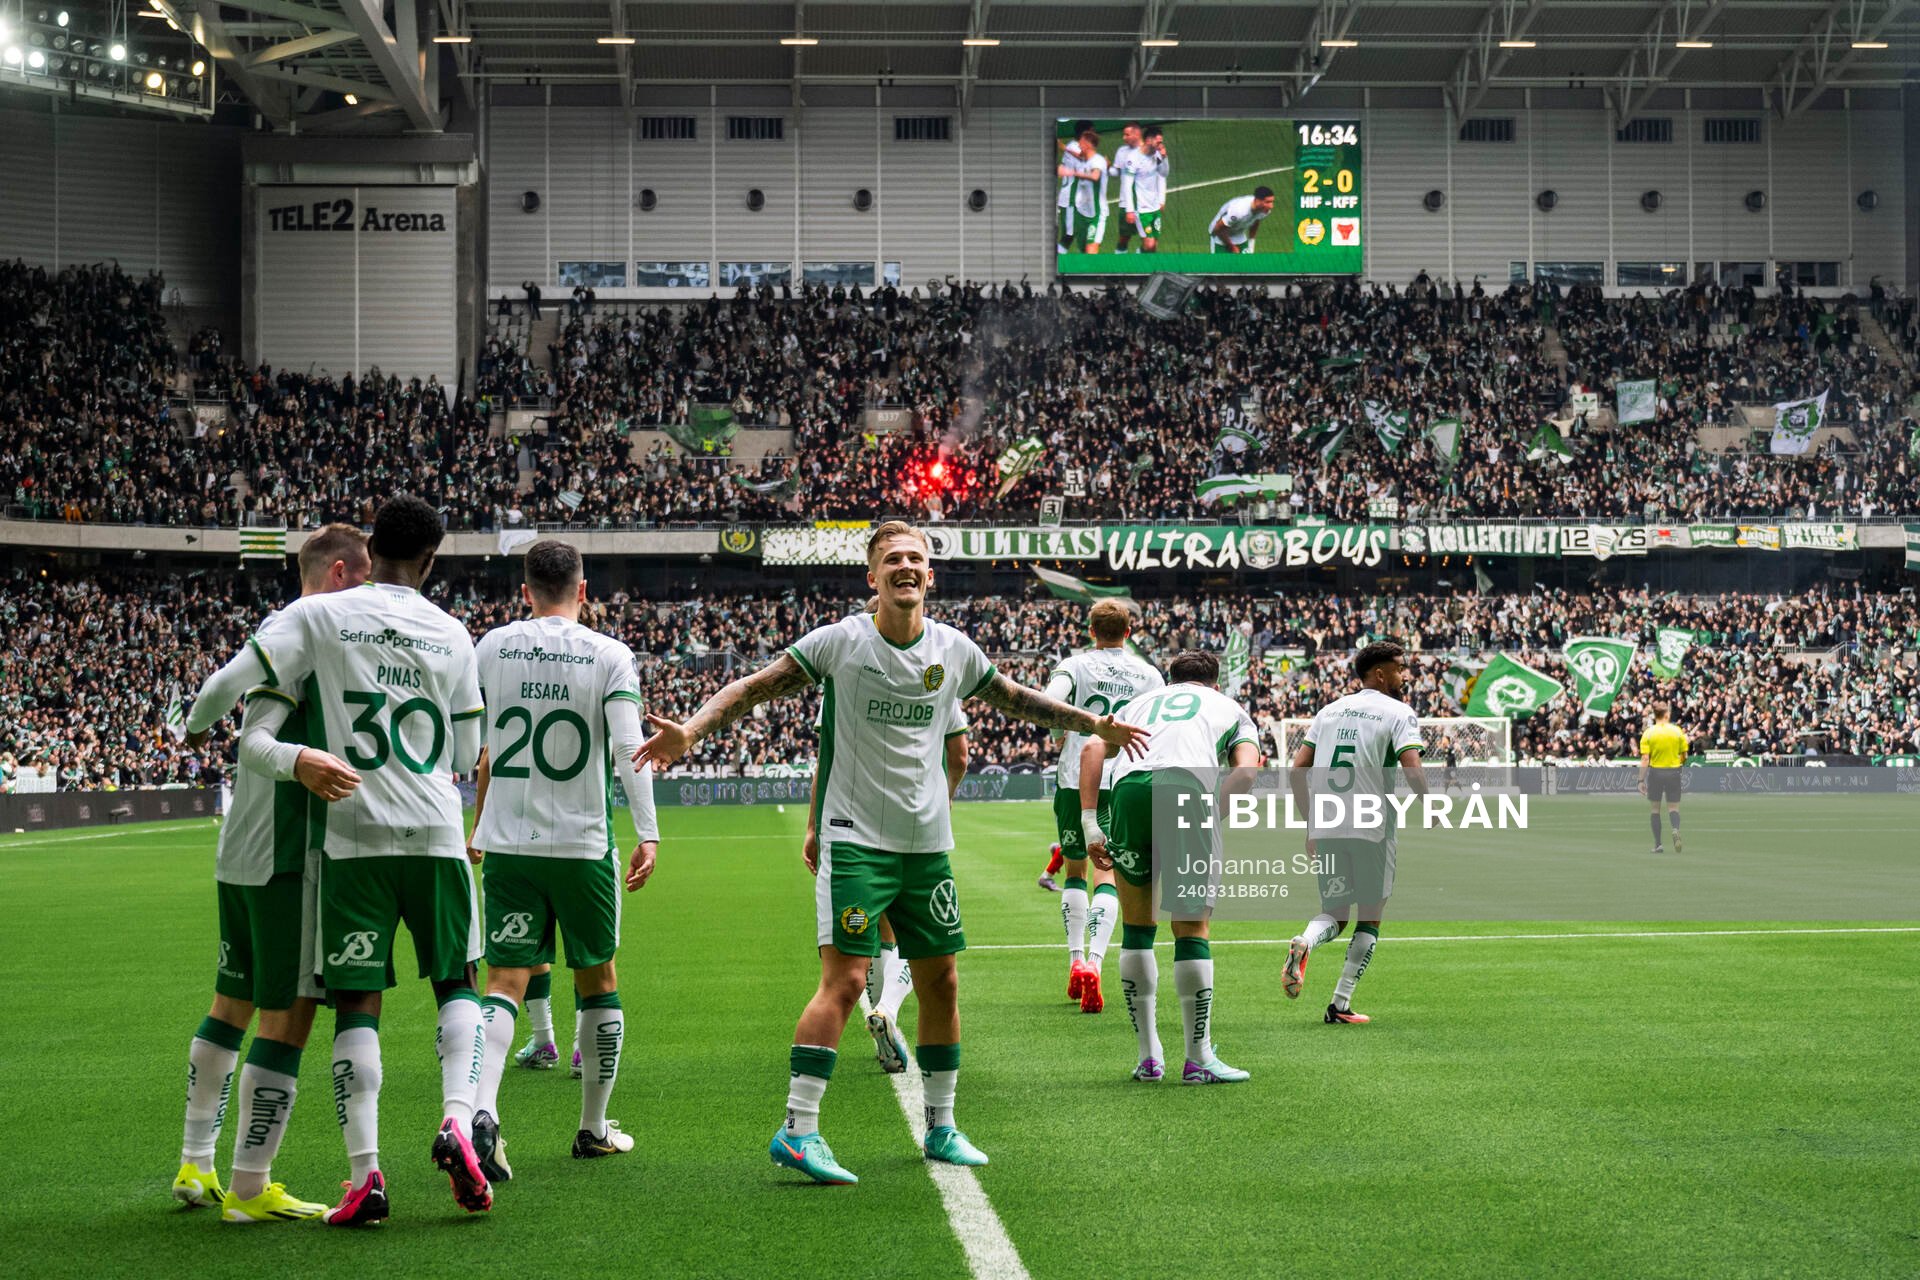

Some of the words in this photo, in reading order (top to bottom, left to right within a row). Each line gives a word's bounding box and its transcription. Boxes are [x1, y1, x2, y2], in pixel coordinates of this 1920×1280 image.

[1299, 124, 1358, 146] 16:34
[268, 199, 354, 231] TELE2
[360, 207, 446, 231] Arena
[1300, 196, 1322, 209] HIF
[1333, 196, 1358, 209] KFF
[961, 530, 1098, 556] ULTRAS
[1107, 529, 1240, 570] ULTRA
[1283, 527, 1386, 567] BOYS
[1428, 526, 1560, 553] KOLLEKTIVET
[340, 629, 386, 645] Sefina
[393, 635, 453, 657] pantbank
[498, 648, 534, 661] Sefina
[539, 651, 596, 665] pantbank
[376, 664, 422, 689] PINAS
[1097, 680, 1134, 697] WINTHER
[520, 682, 570, 701] BESARA
[867, 699, 935, 721] PROJOB
[1147, 693, 1202, 725] 19
[343, 690, 446, 774] 30
[491, 706, 591, 782] 20
[1337, 728, 1358, 740] TEKIE
[1327, 745, 1356, 793] 5
